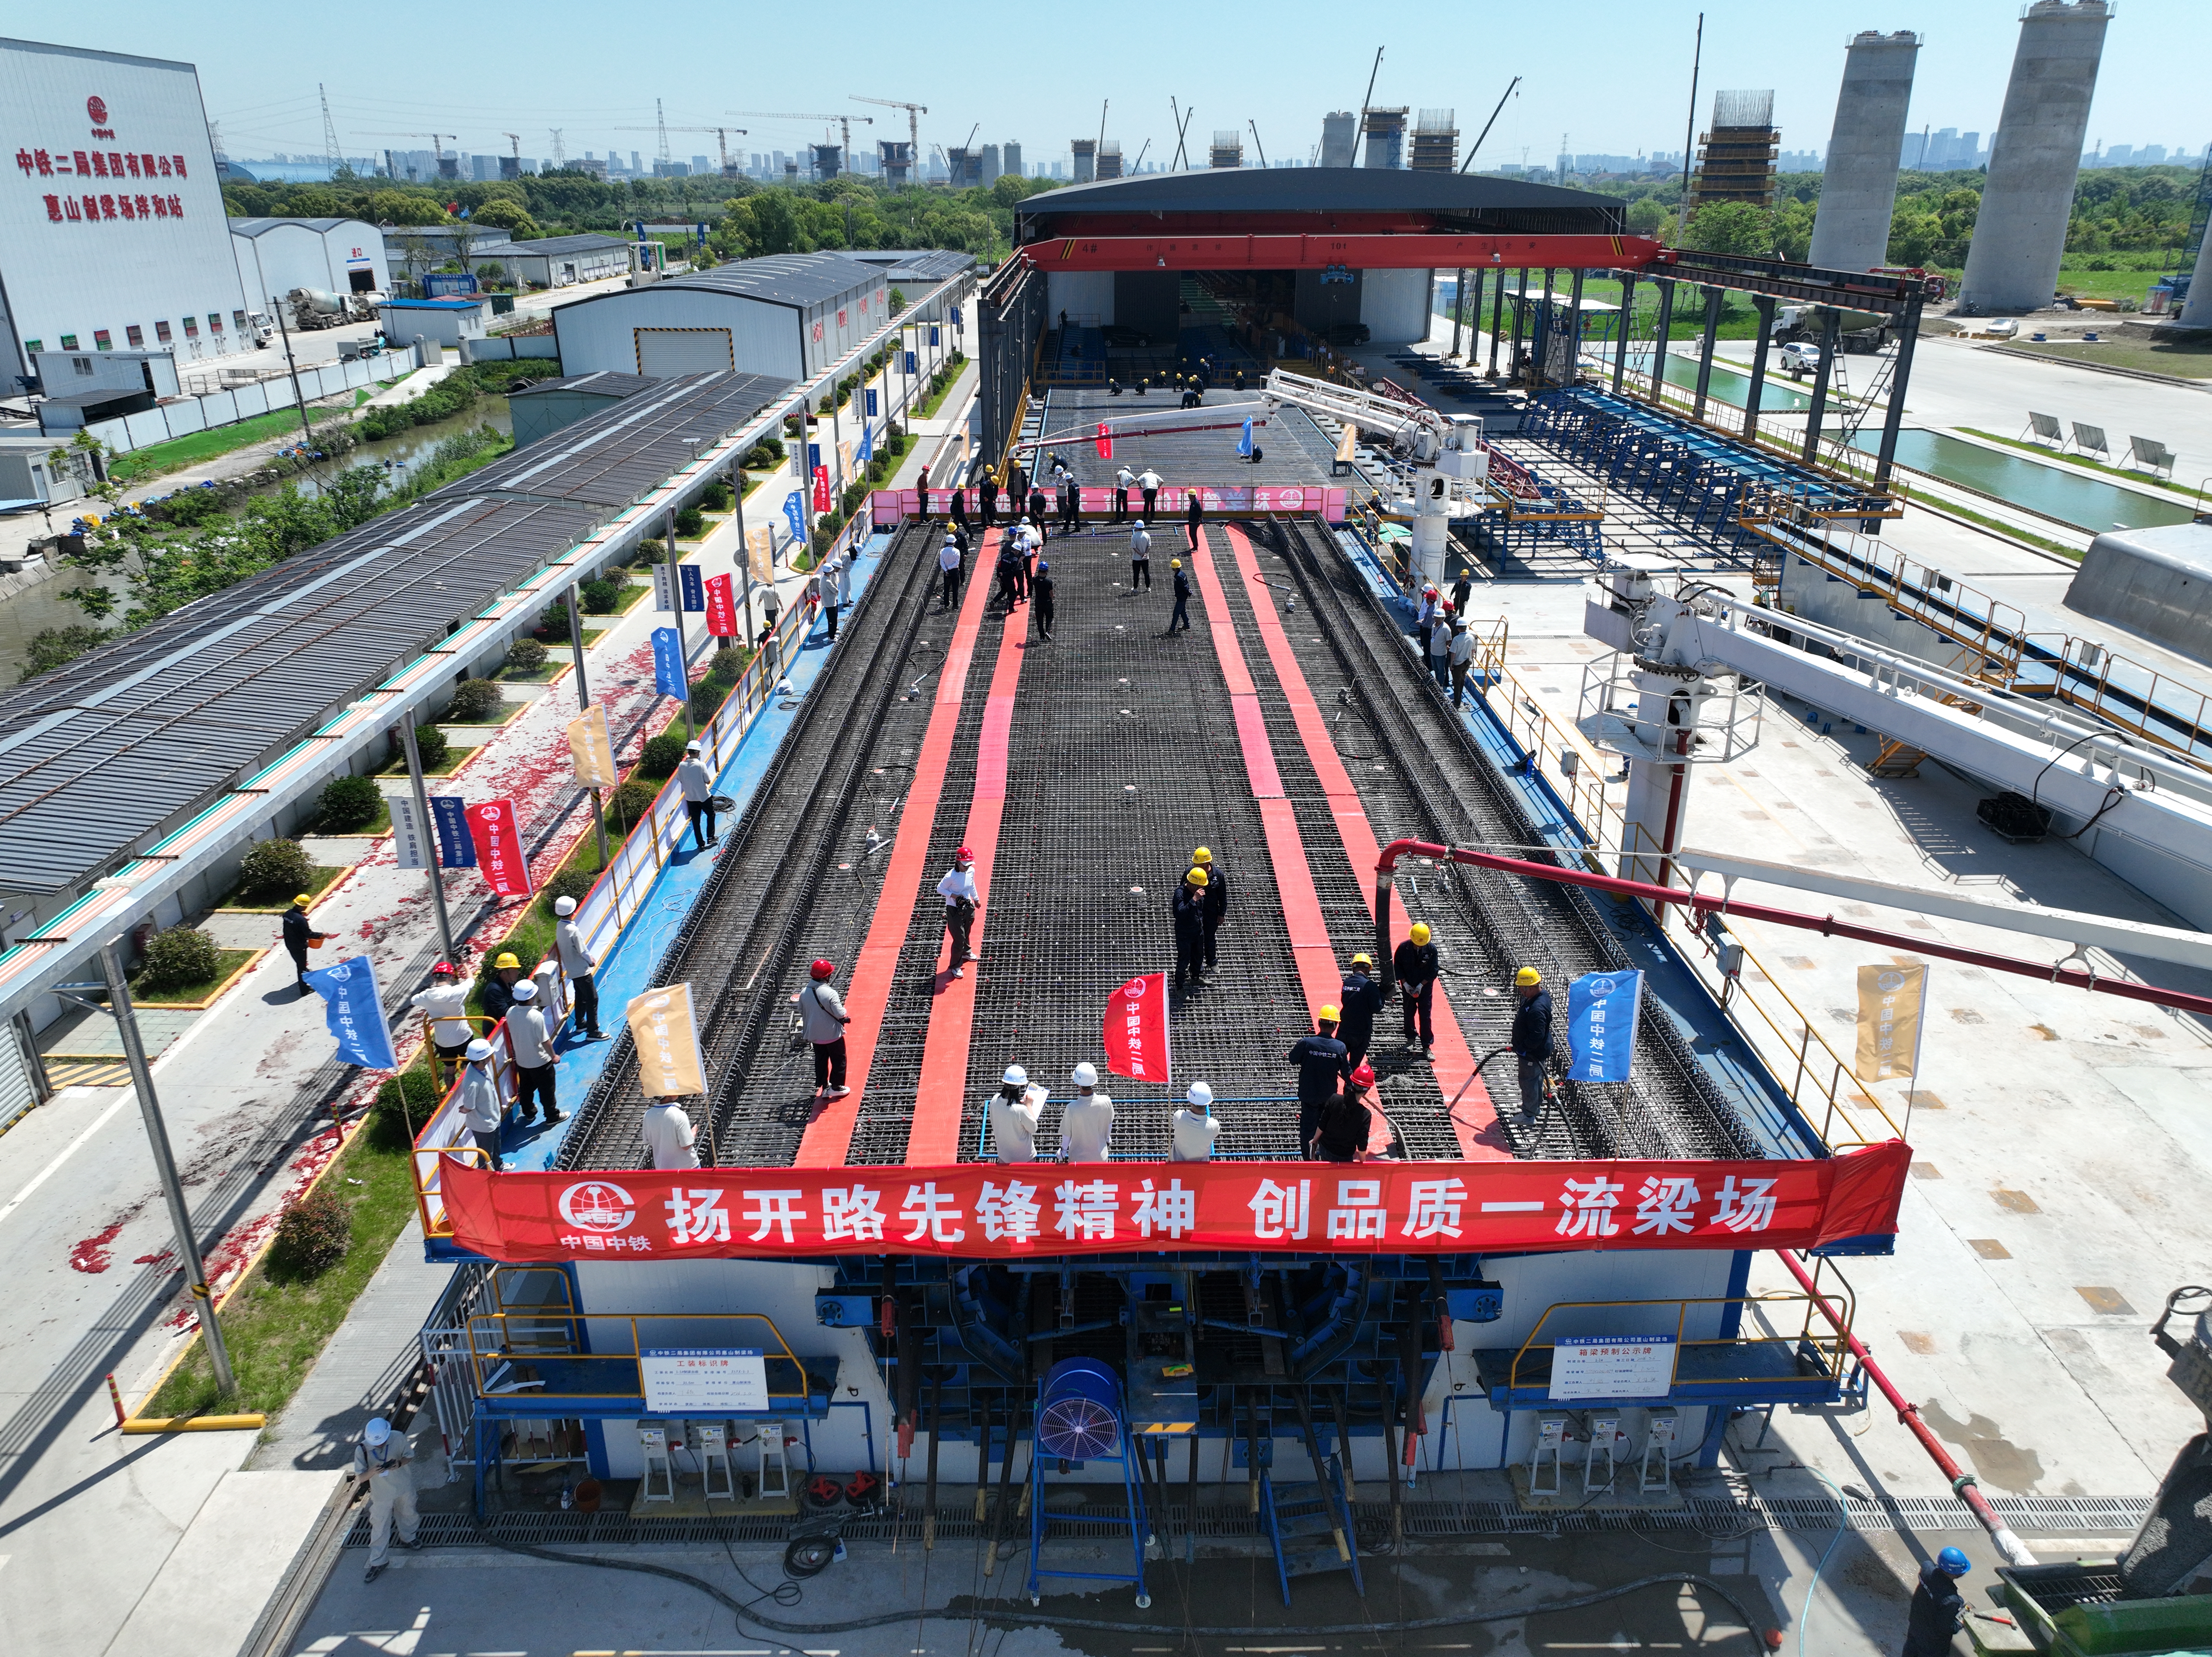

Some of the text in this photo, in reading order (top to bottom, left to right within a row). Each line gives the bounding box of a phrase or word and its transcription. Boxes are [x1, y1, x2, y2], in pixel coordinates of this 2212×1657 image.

[16, 148, 187, 178] 中铁二局集团有限公司
[43, 194, 184, 221] 惠山制梁场拌和站
[1083, 243, 1098, 253] 4#
[401, 800, 418, 865] 中国建造 铁肩担当
[447, 811, 463, 865] 中国中铁二局集团
[1309, 1050, 1337, 1059] 中国中铁二局
[665, 1175, 1779, 1243] 扬开路先锋精神 创品质一流梁场
[559, 1234, 652, 1252] 中国中铁
[1579, 1347, 1652, 1356] 箱梁预制公示牌
